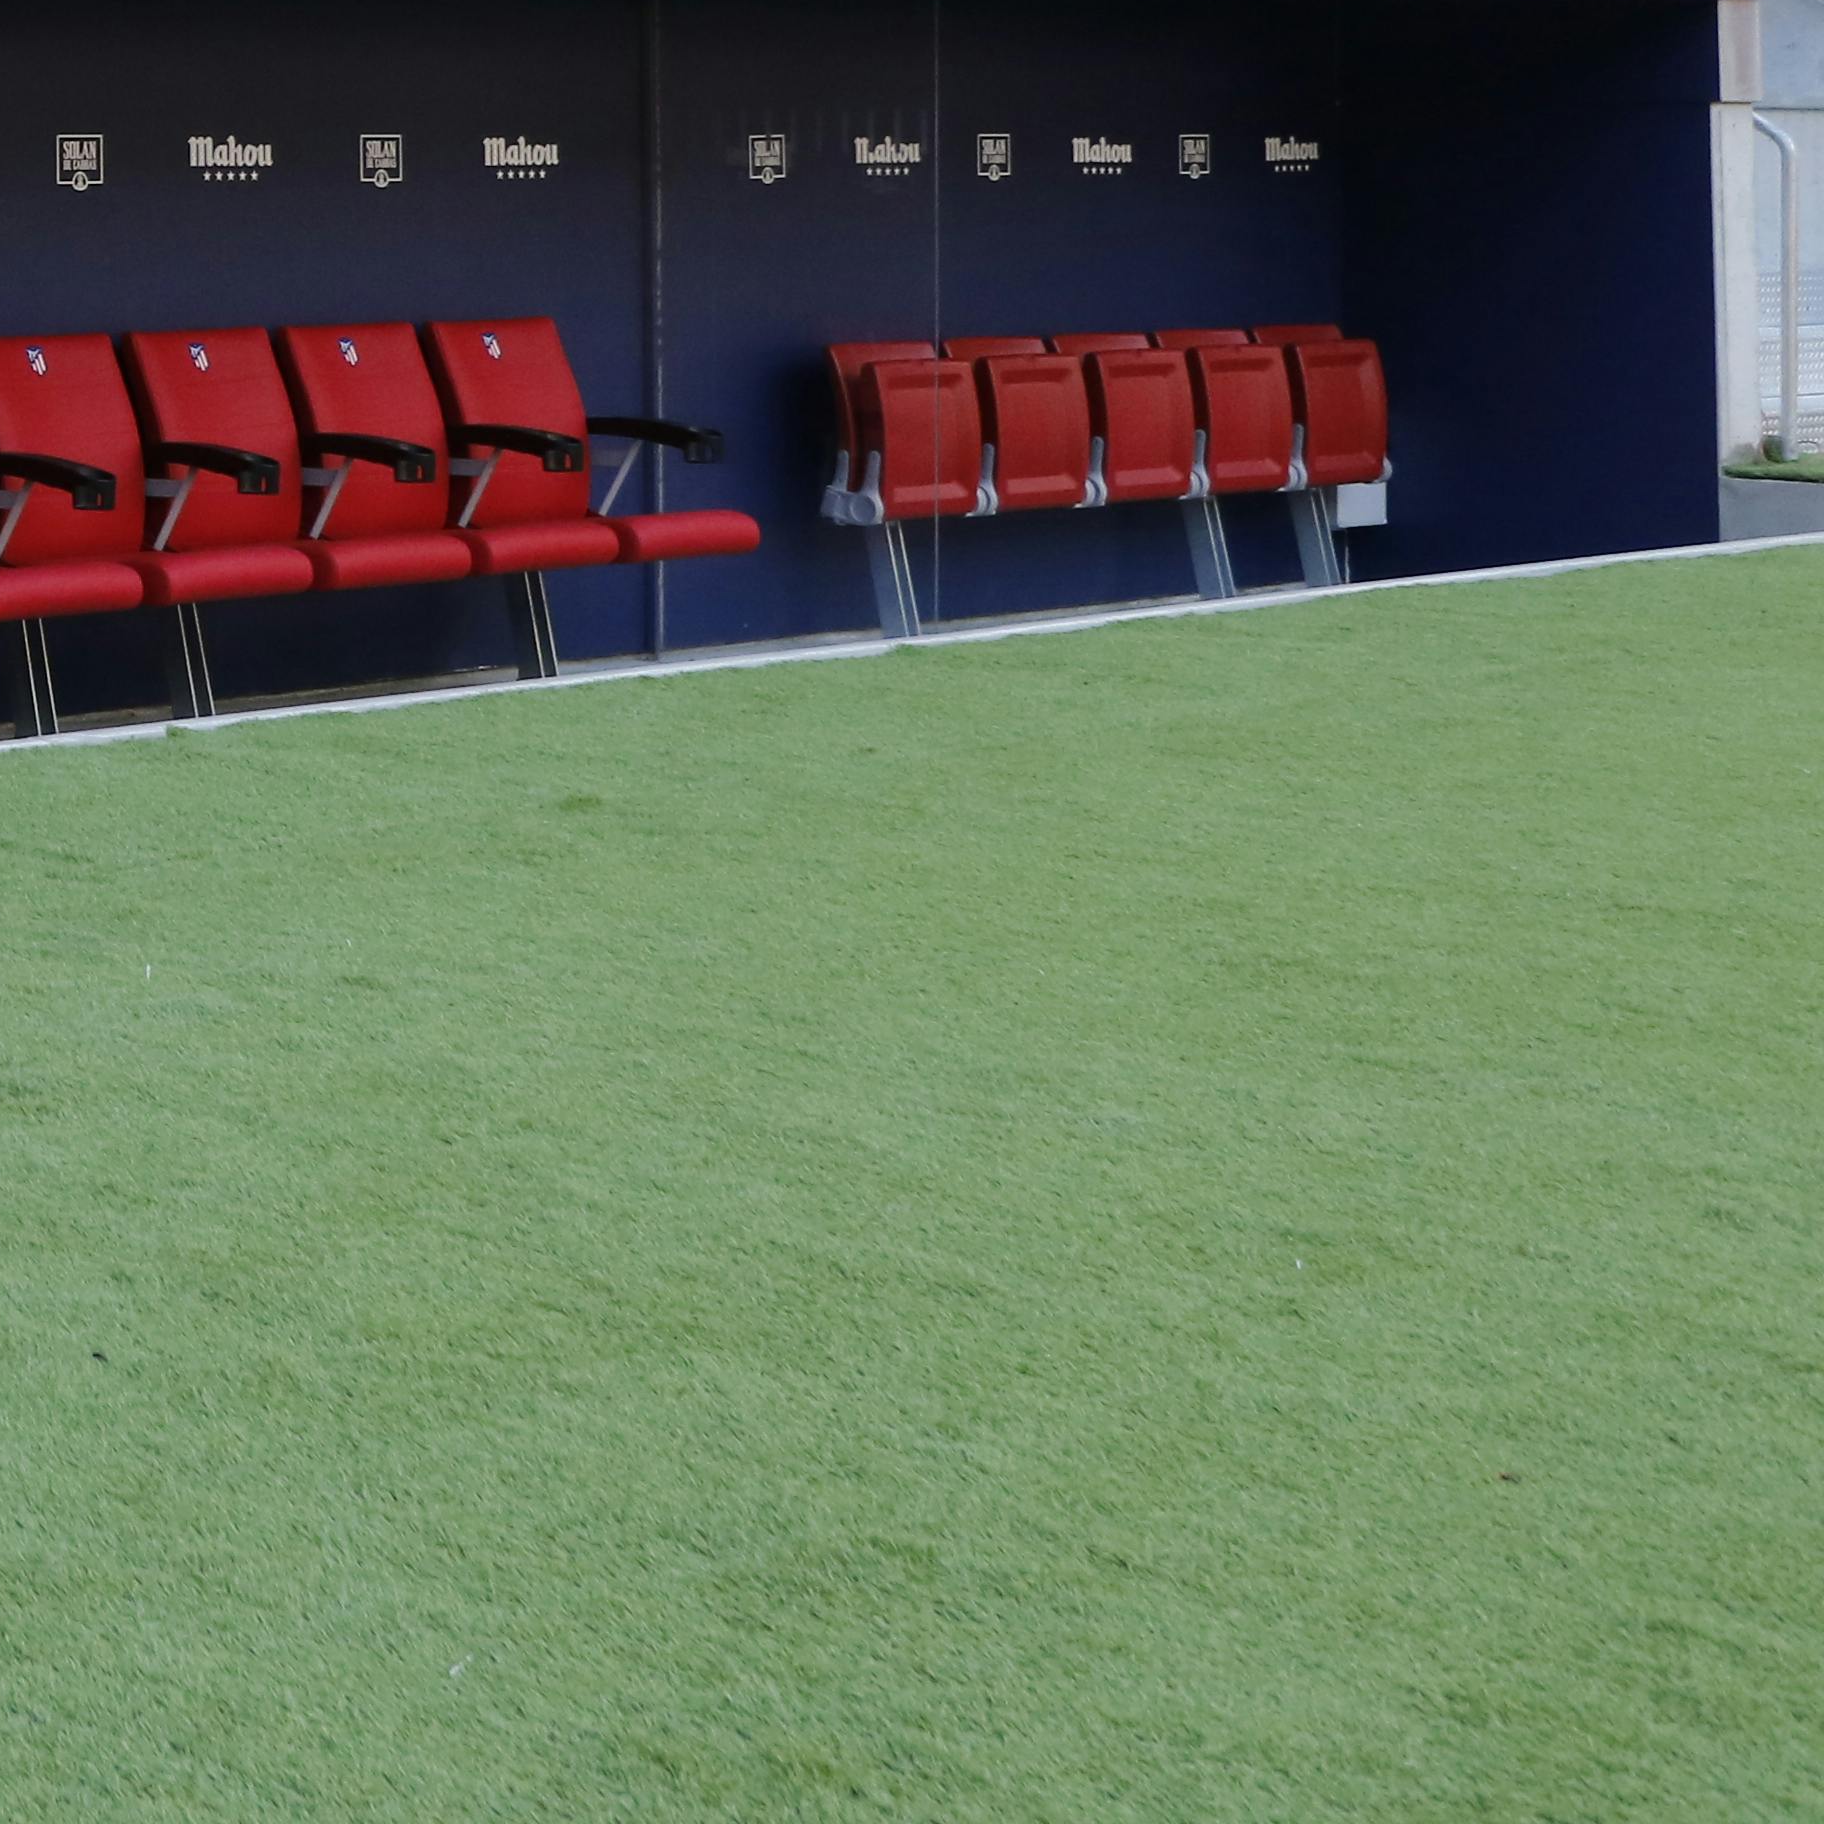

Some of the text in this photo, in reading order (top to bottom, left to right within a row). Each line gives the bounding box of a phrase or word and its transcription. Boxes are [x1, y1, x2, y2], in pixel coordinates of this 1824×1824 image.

[188, 135, 273, 166] Mahou
[483, 136, 559, 166] Mahou
[1072, 137, 1132, 163] Mahou
